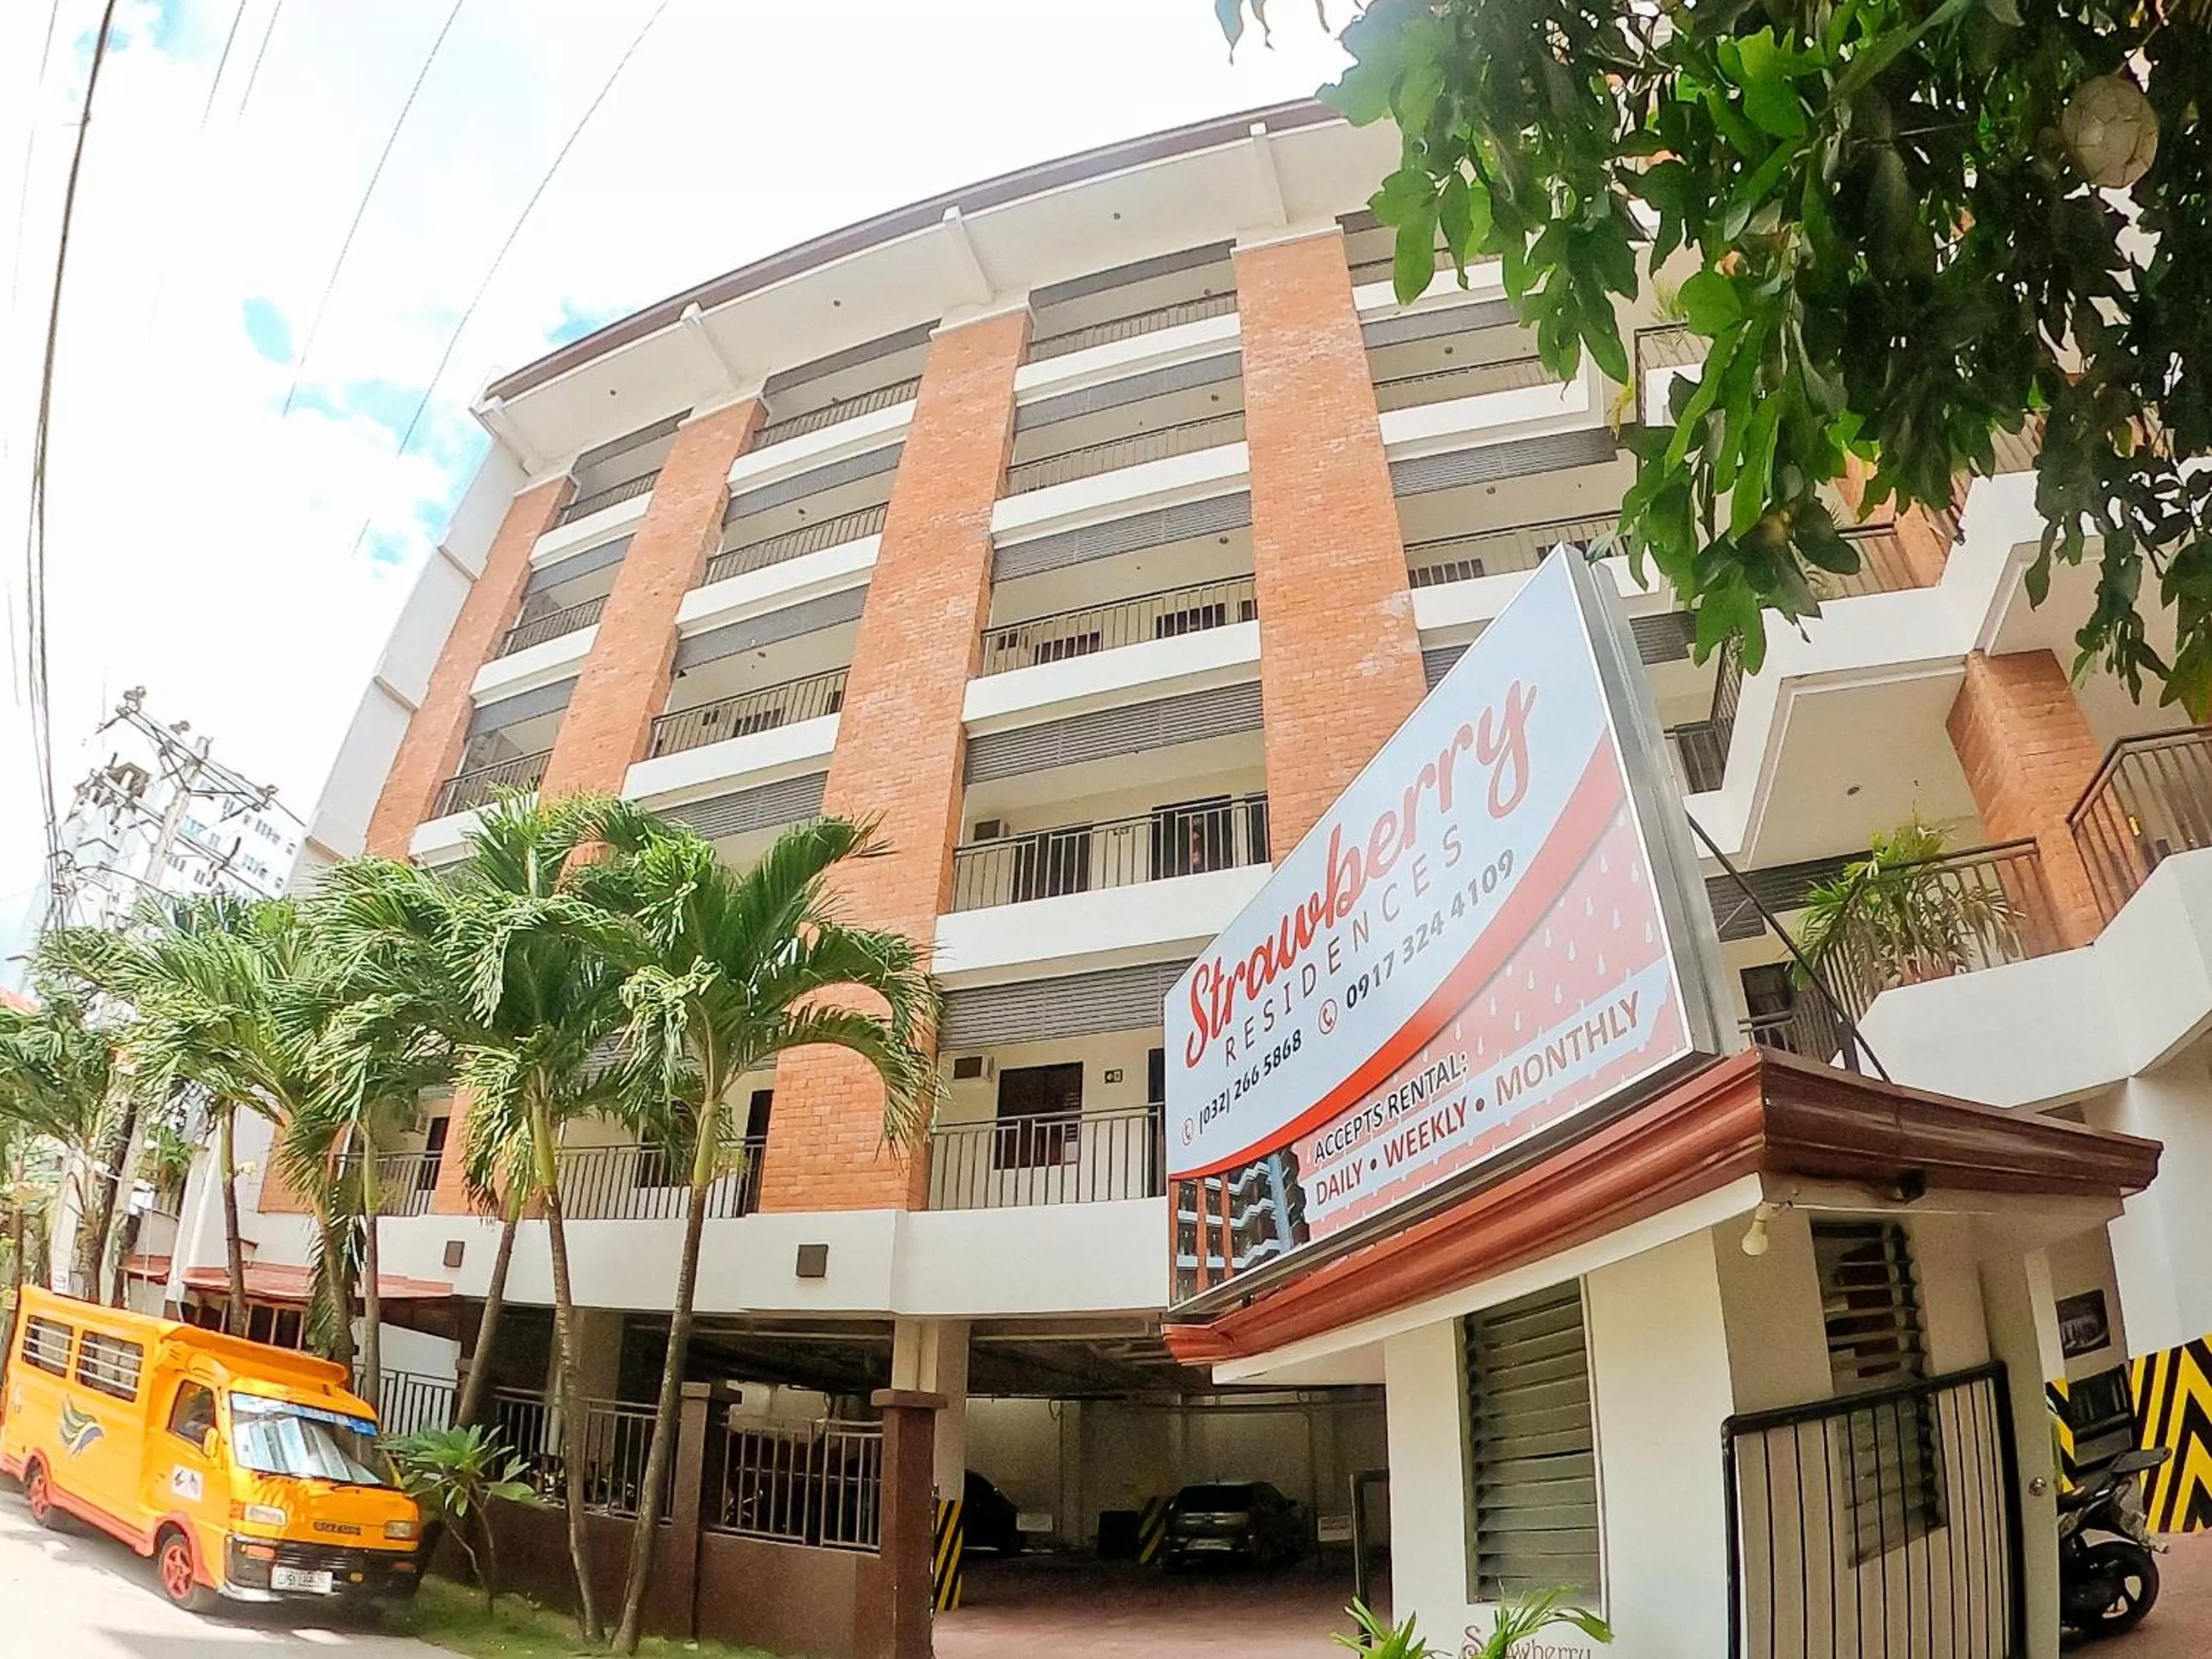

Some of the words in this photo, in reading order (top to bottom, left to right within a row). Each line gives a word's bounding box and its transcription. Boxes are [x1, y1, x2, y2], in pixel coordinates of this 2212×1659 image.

[1185, 680, 1537, 1069] Strawberry
[1225, 824, 1461, 1067] RESIDENCES
[1346, 949, 1395, 1009] 0917
[1402, 912, 1444, 964] 324
[1450, 848, 1514, 919] 4109
[1234, 1071, 1260, 1101] 266
[1263, 1028, 1302, 1077] 5868
[1314, 1102, 1384, 1165] ACCEPTS
[1388, 1053, 1467, 1119] RENTAL:
[1316, 1158, 1364, 1207] DAILY
[1383, 1096, 1467, 1169] WEEKLY
[1496, 990, 1639, 1107] MONTHLY
